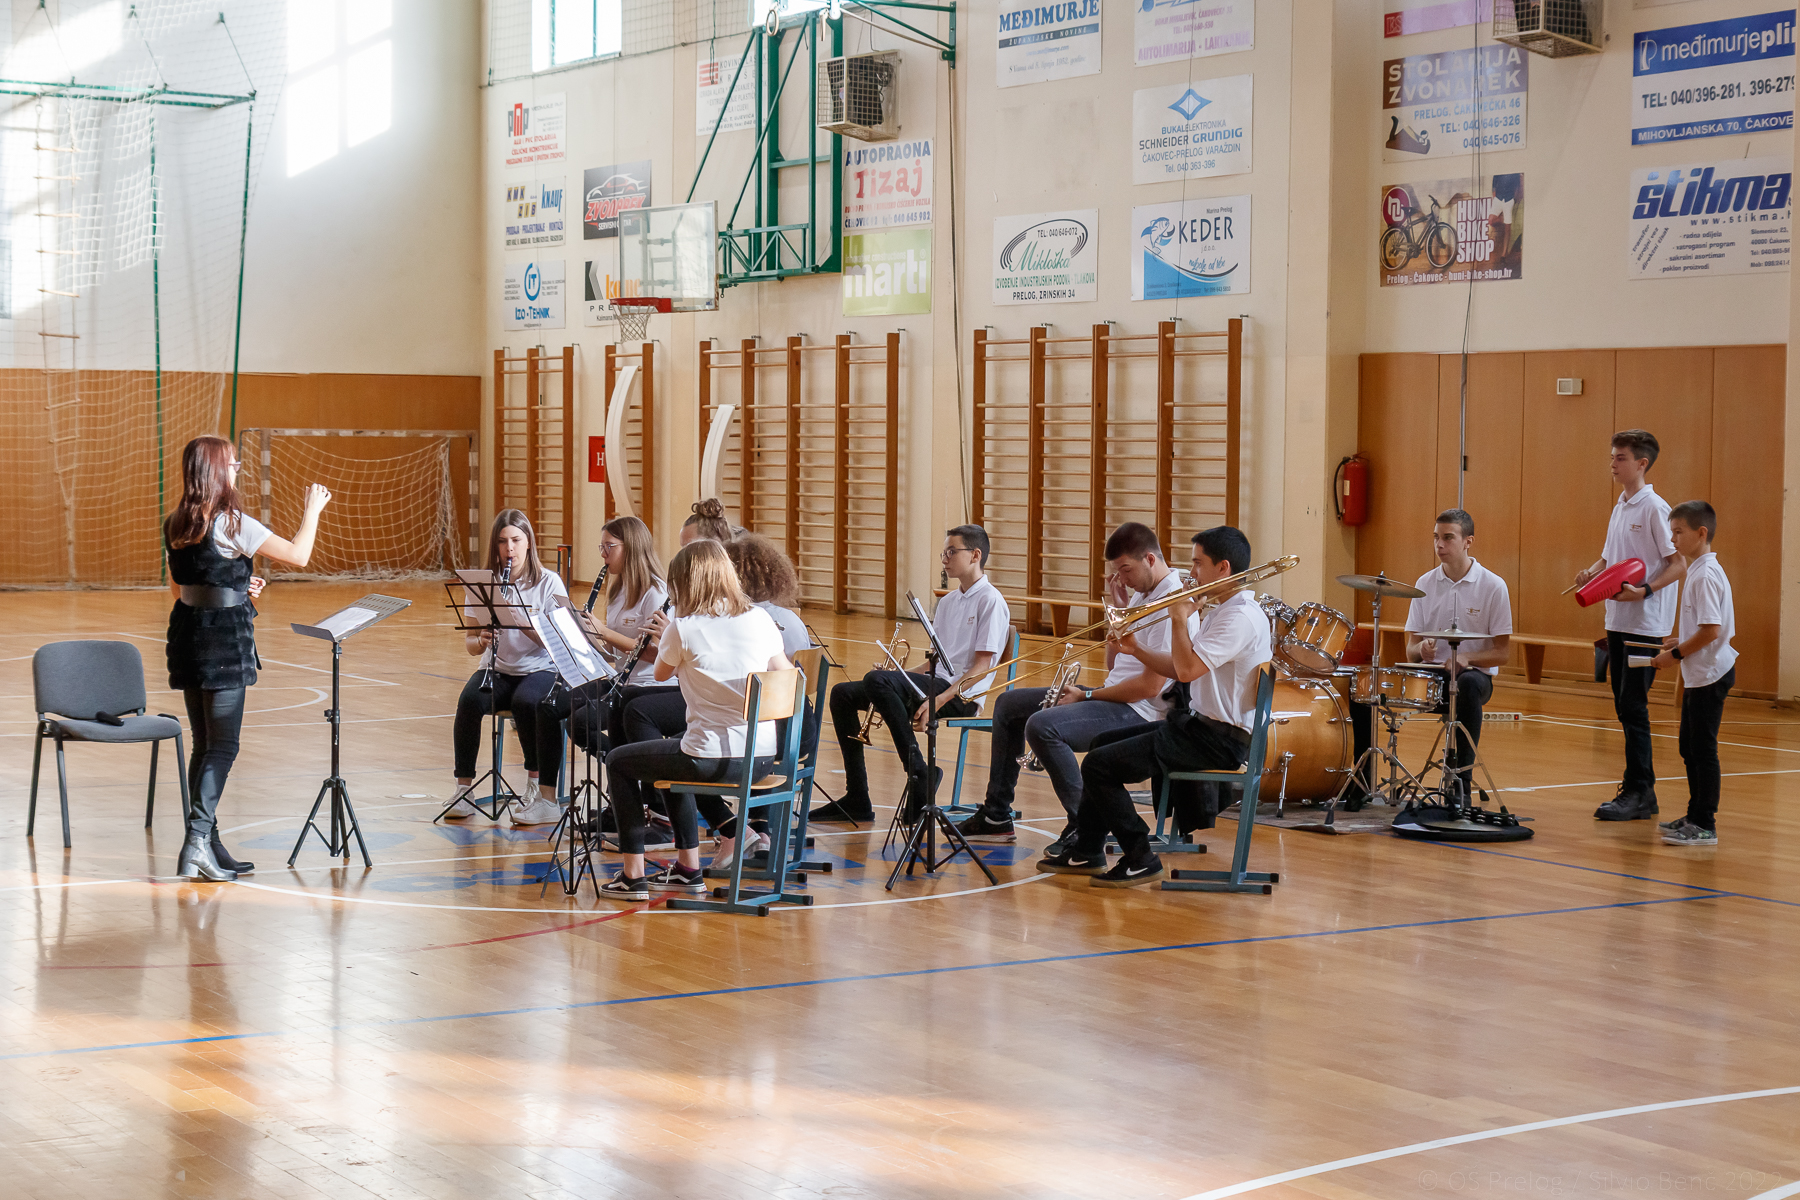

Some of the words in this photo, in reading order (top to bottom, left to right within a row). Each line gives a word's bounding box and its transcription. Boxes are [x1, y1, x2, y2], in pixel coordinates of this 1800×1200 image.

[999, 0, 1099, 32] MEĐIMURJE
[1009, 32, 1054, 45] ŽUPANIJSKE
[1060, 26, 1087, 37] NOVINE
[1389, 47, 1521, 81] STOLARIJA
[1509, 98, 1520, 108] 46
[1642, 93, 1667, 109] TEL:
[1440, 122, 1460, 133] TEL:
[1638, 123, 1724, 141] MIHOVLJANSKA
[1745, 114, 1793, 130] ČAKOVE
[1139, 135, 1189, 150] SCHNEIDER
[1192, 128, 1242, 143] GRUNDIG
[1206, 142, 1240, 155] VARAŽDIN
[845, 141, 931, 166] AUTOPRAONA
[1633, 166, 1792, 220] štikma
[906, 212, 918, 222] 645
[919, 211, 930, 221] 982
[1457, 198, 1493, 221] HUNI
[1038, 229, 1048, 237] TEL:
[1049, 228, 1058, 237] 040
[1179, 216, 1233, 244] KEDER
[1457, 220, 1489, 241] BIKE
[1009, 240, 1071, 272] Mikloška
[1457, 240, 1494, 263] SHOP
[1709, 241, 1735, 250] program
[845, 249, 926, 298] marti
[1387, 274, 1408, 284] Prelog
[1414, 272, 1443, 283] Čakovec
[1039, 289, 1066, 299] ZRINSKIH
[1068, 289, 1075, 298] 34
[597, 452, 605, 466] H
